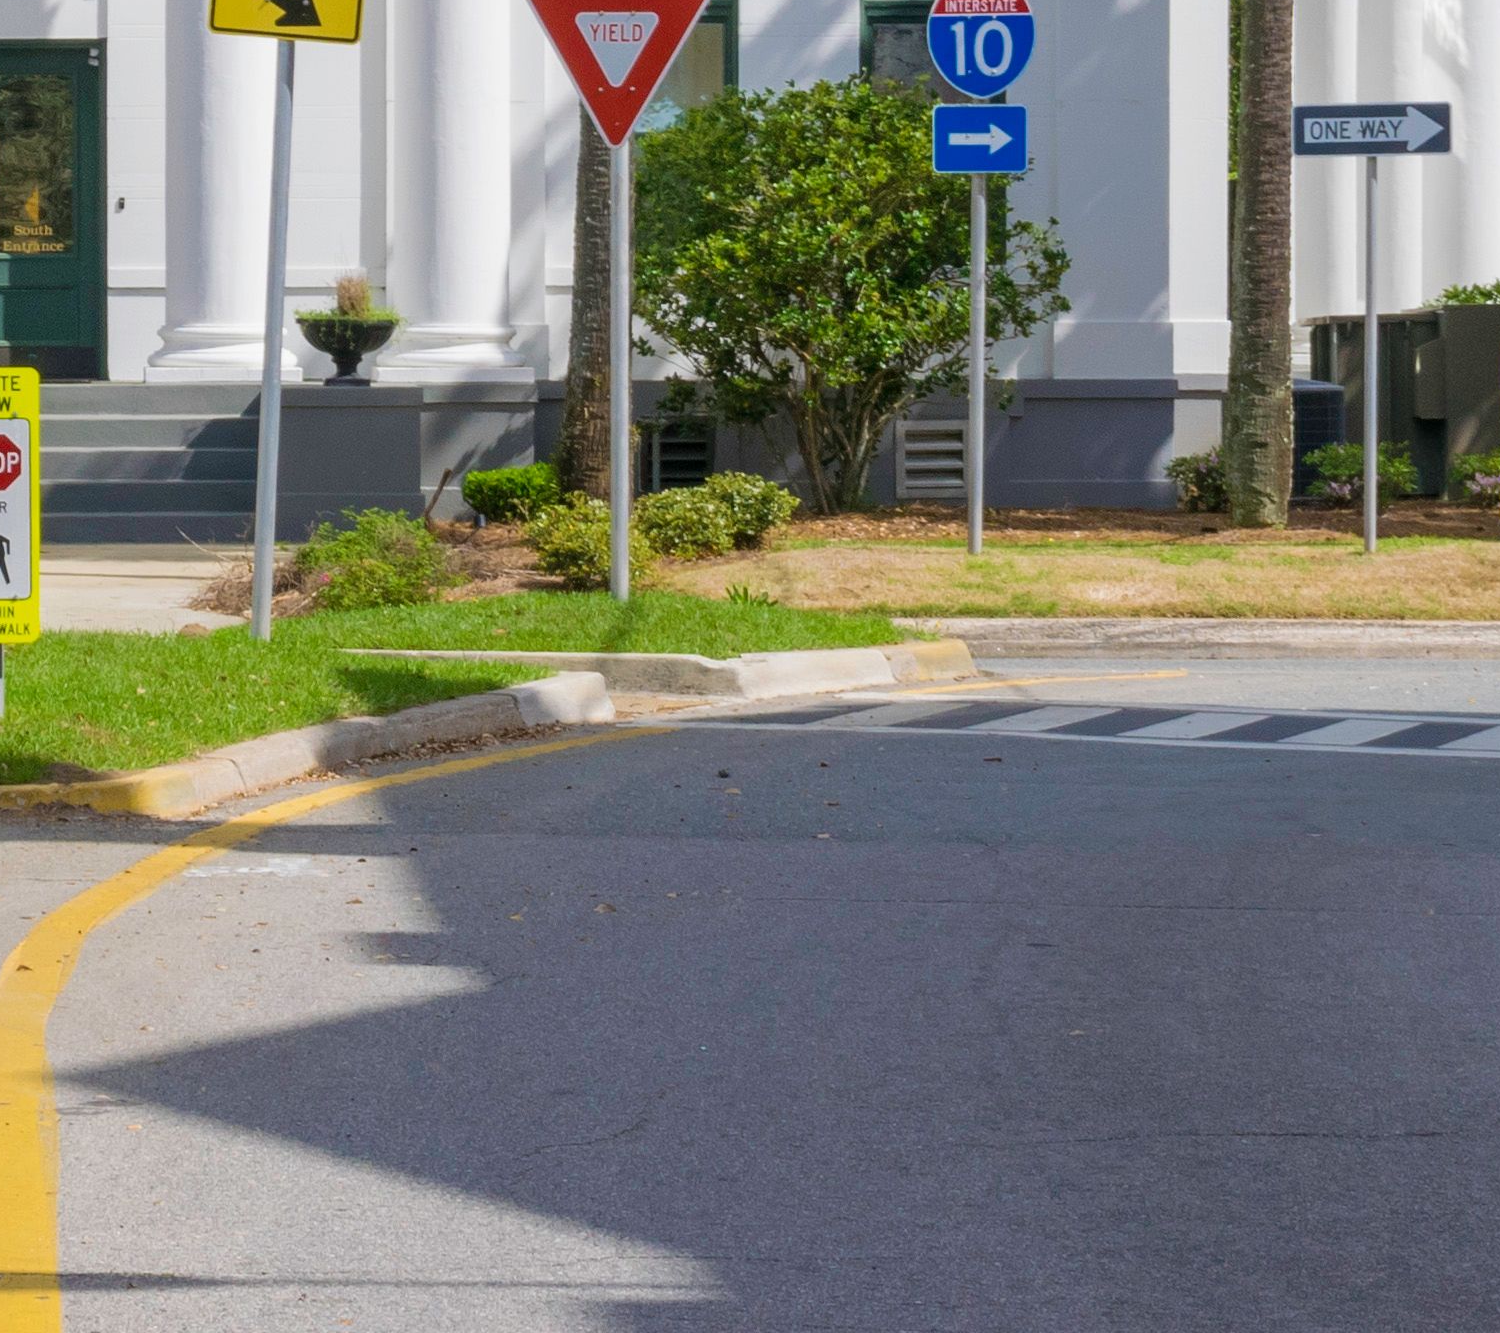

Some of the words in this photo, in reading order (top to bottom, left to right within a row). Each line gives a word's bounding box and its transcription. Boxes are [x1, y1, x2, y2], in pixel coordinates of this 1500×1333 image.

[945, 0, 1018, 13] INTERSTATE
[590, 23, 643, 42] YIELD
[950, 20, 1013, 77] 10
[1310, 121, 1350, 140] ONE
[1360, 119, 1402, 138] WAY
[13, 225, 53, 236] South
[3, 241, 65, 252] Entrance
